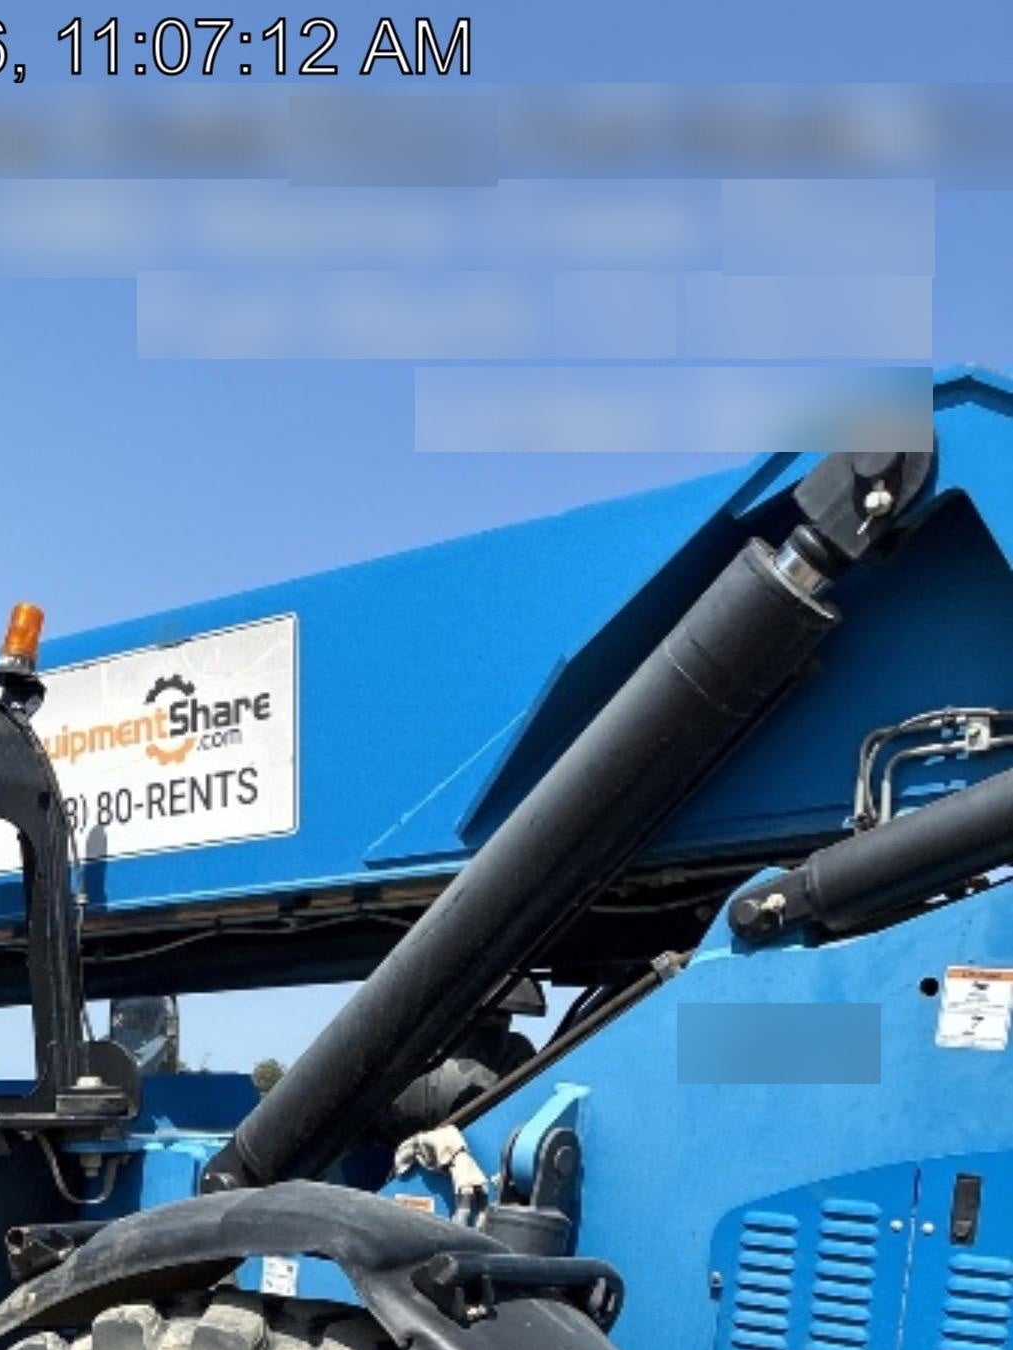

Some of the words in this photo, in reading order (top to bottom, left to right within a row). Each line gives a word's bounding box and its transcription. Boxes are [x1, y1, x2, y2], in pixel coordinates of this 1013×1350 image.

[43, 692, 271, 765] uipmentShare
[196, 728, 243, 752] .com
[97, 766, 259, 827] 80-RENTS
